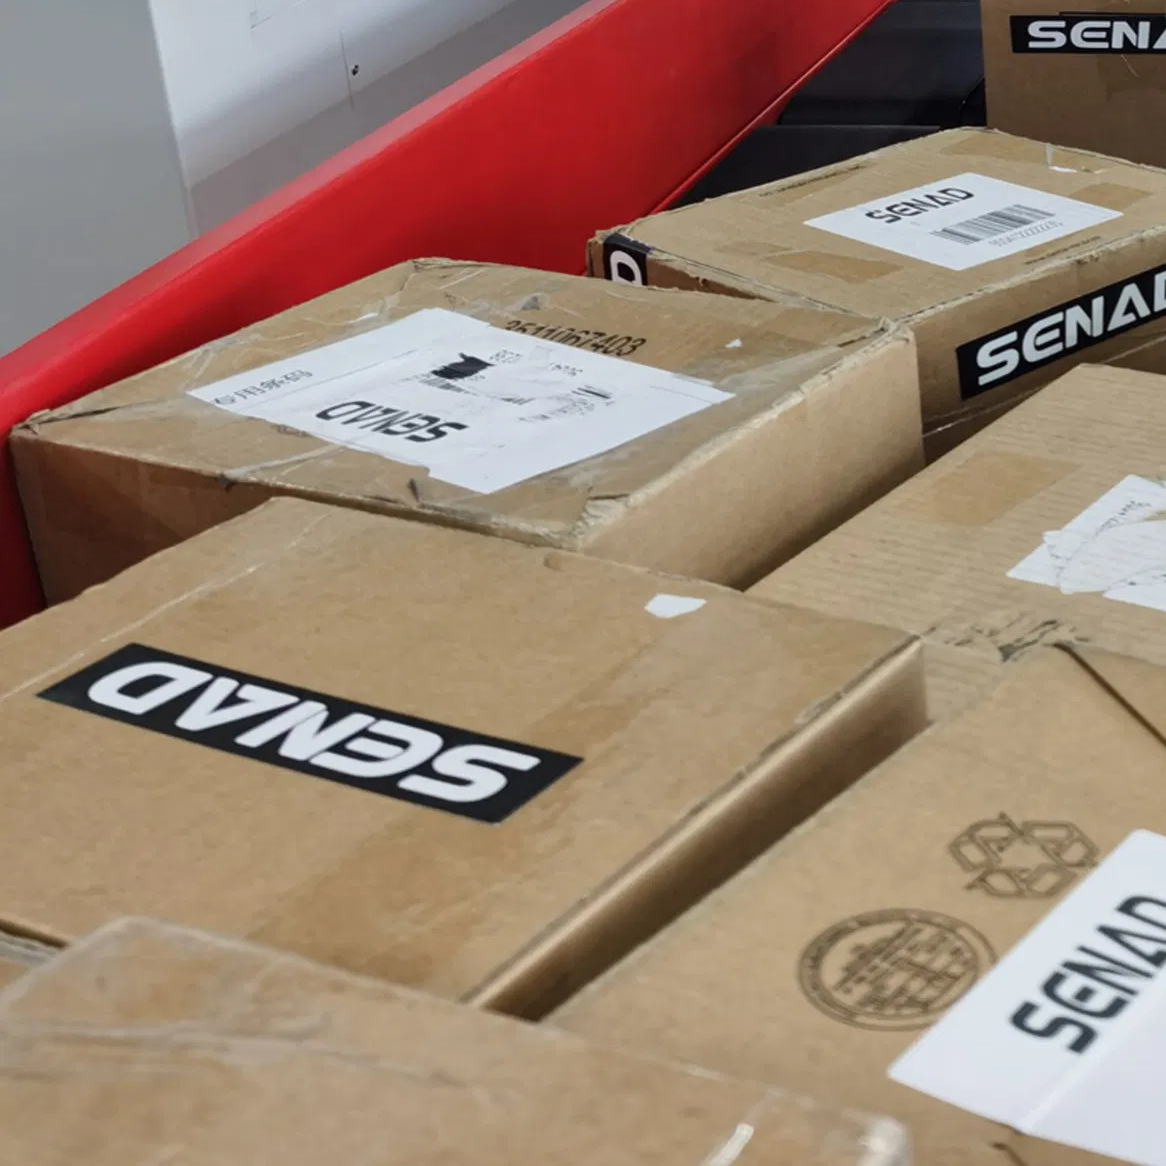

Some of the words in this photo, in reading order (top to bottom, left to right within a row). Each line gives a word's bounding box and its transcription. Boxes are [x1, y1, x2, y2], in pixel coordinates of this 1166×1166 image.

[865, 187, 975, 224] SENAD
[315, 400, 469, 443] SENAD
[88, 661, 541, 803] SENAD
